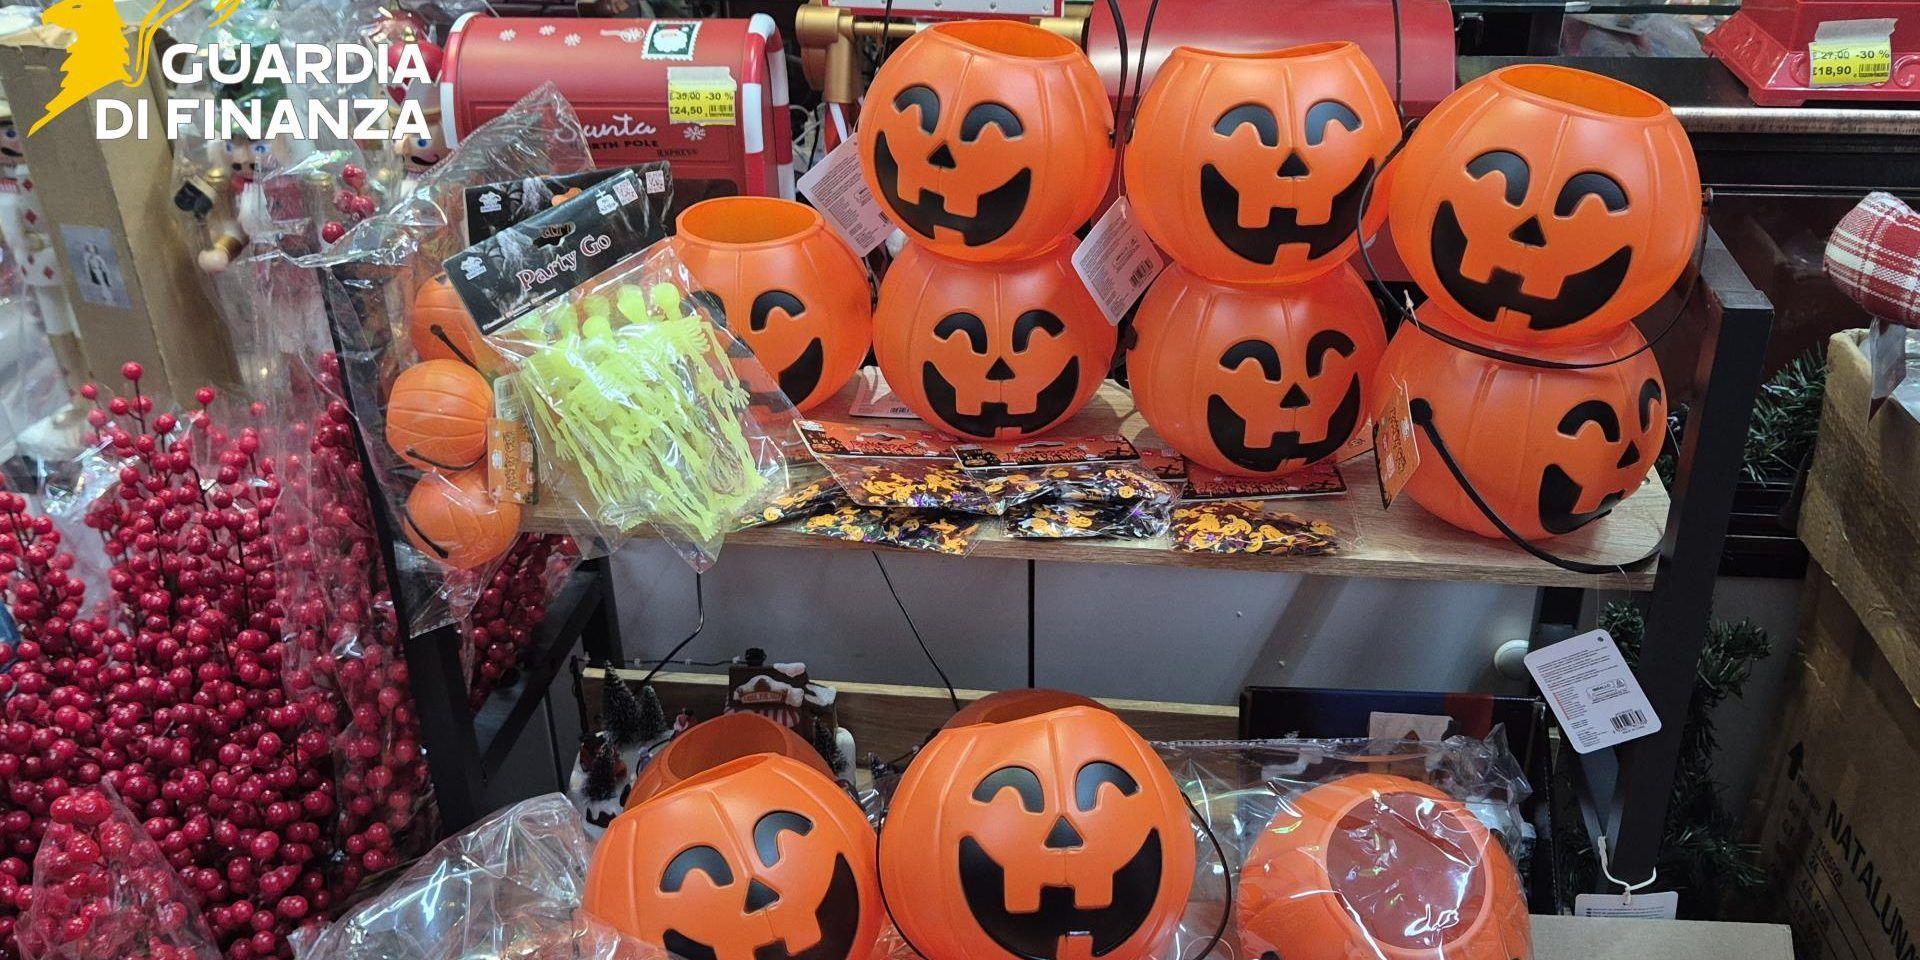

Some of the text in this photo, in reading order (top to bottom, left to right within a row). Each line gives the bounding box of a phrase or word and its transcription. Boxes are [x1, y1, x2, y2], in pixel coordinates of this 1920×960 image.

[1856, 50, 1875, 59] -30
[1878, 49, 1890, 59] %
[705, 92, 721, 100] -30
[554, 113, 657, 143] Santa
[624, 139, 660, 149] POLE
[516, 250, 577, 293] Party
[580, 234, 612, 258] Go
